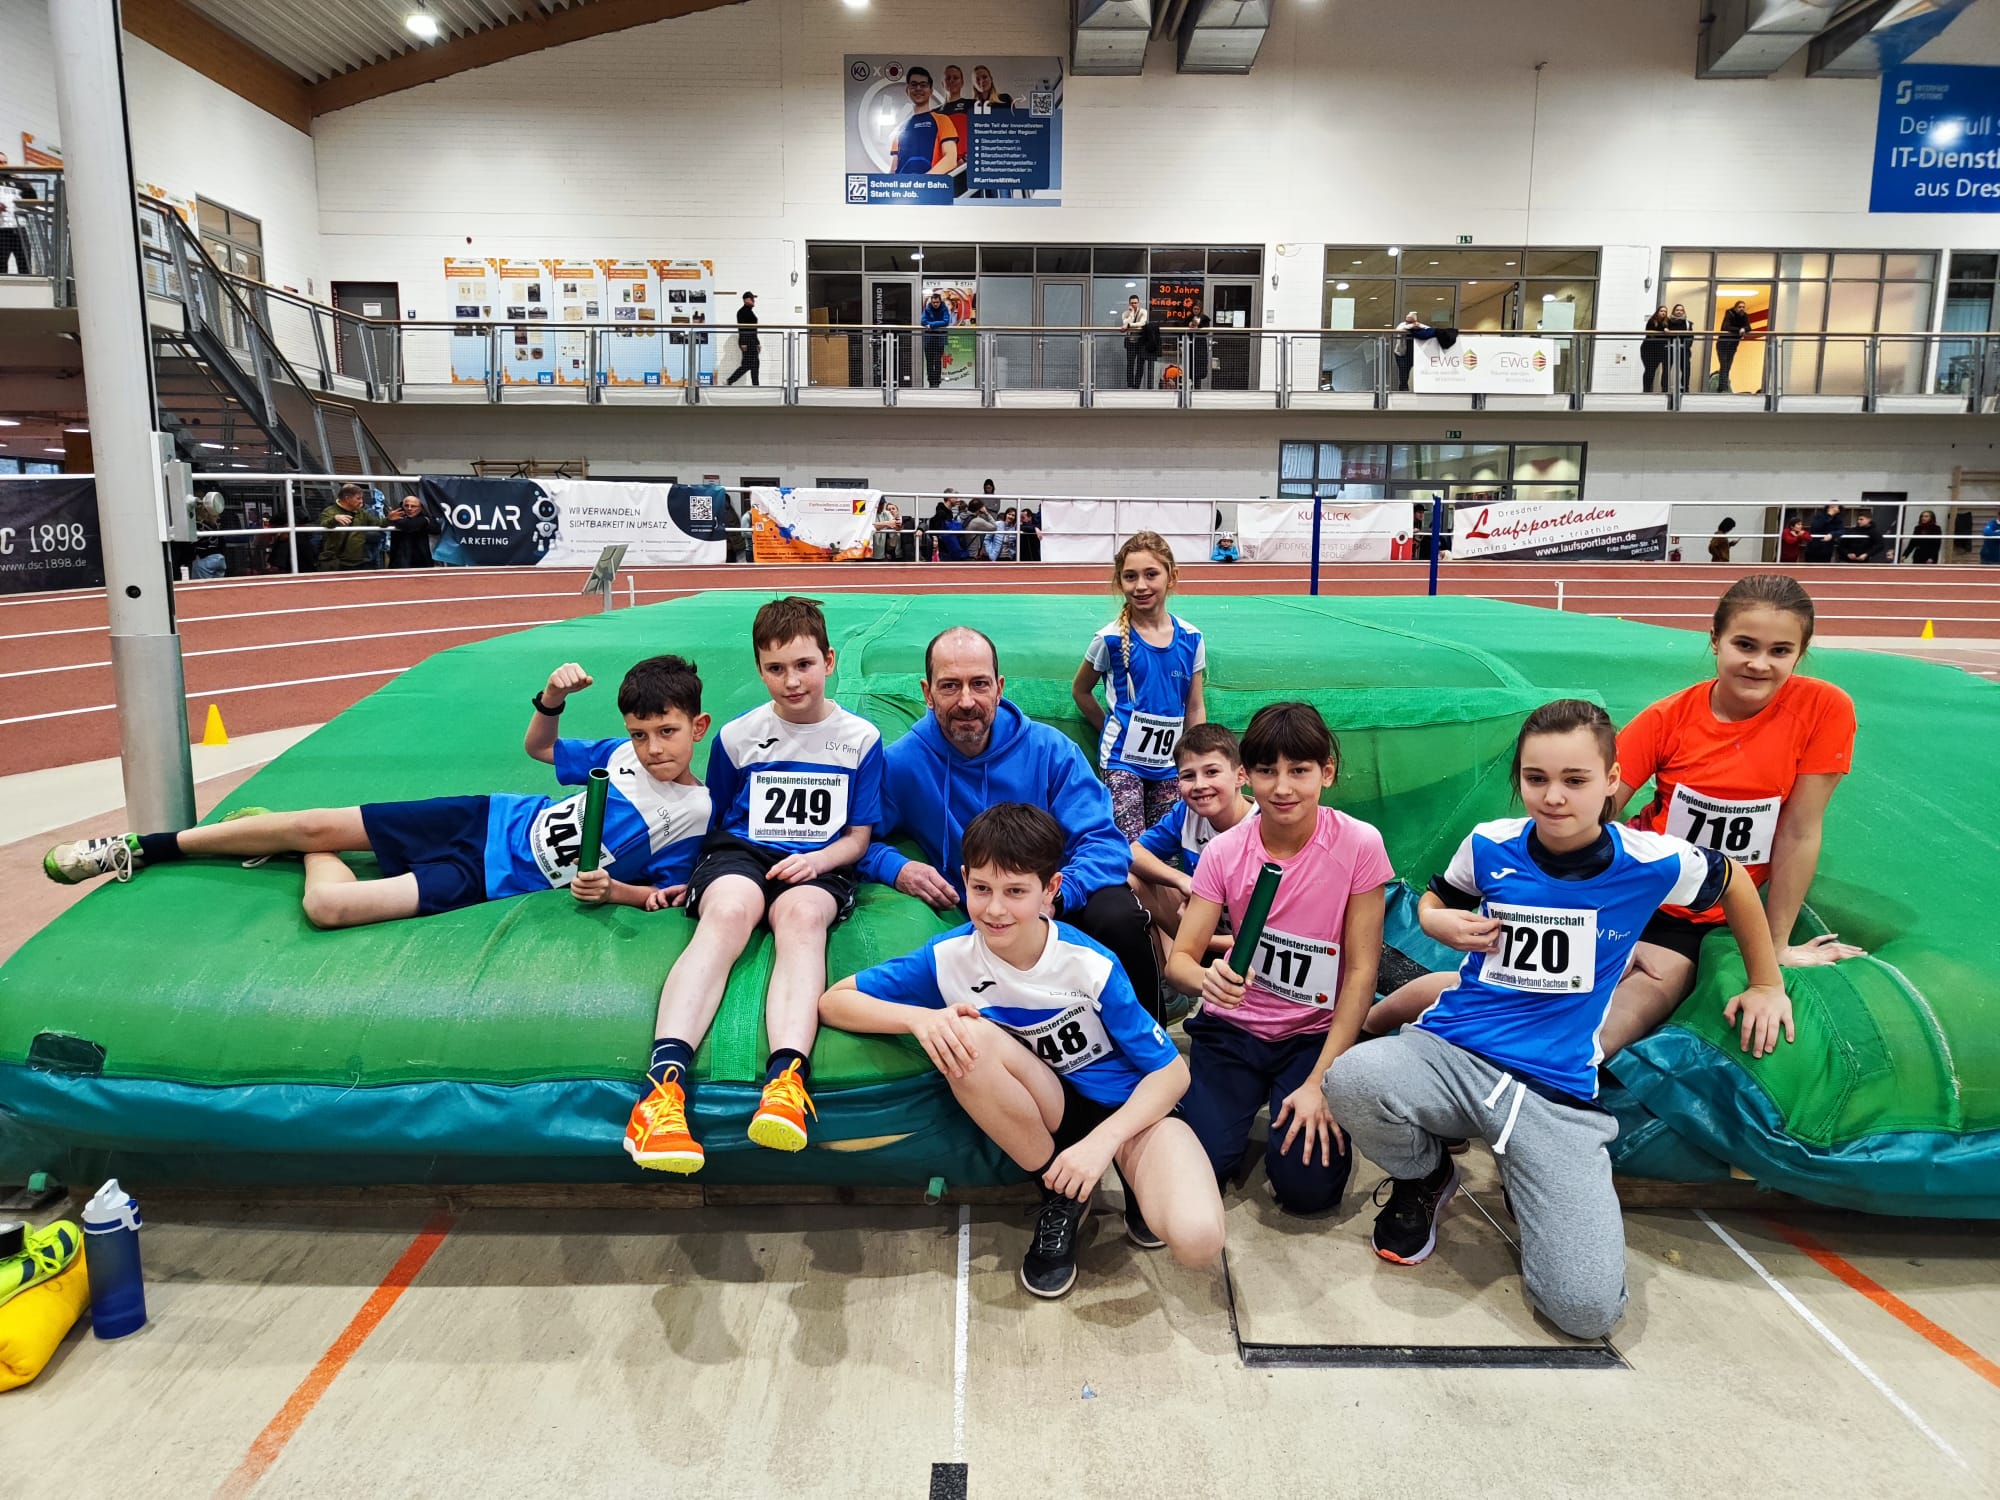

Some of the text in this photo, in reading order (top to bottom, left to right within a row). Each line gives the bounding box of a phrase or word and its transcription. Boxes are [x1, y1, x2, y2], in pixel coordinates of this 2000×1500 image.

[870, 180, 949, 189] Schnell auf der Bahn.
[1914, 182, 1949, 197] aus
[870, 190, 890, 198] Stark
[891, 190, 901, 198] im
[902, 190, 919, 198] Job.
[1159, 285, 1200, 294] 30 Jahre
[1151, 298, 1182, 306] Kinder
[1166, 309, 1192, 319] proje
[1430, 356, 1460, 368] EWG
[1500, 356, 1529, 369] EWG
[582, 506, 641, 516] VERWANDELN
[1297, 511, 1351, 521] KUKLICK
[1498, 504, 1543, 518] Dresdner
[626, 520, 635, 529] IN
[637, 520, 668, 529] UMSATZ
[1465, 506, 1617, 540] Laufsportladen
[28, 523, 86, 553] 1898
[460, 537, 509, 546] ARKETING
[1522, 534, 1555, 547] skiing
[1570, 523, 1619, 538] triathlon
[1535, 531, 1637, 557] www.laufsportladen.de
[825, 741, 840, 751] LSV
[1137, 726, 1175, 756] 719
[756, 775, 841, 787] Regionalmeisterschaft
[764, 787, 832, 826] 249
[1677, 790, 1772, 814] Regionalmeisterschaft
[545, 803, 582, 868] 244
[1685, 807, 1754, 851] 718
[1490, 908, 1585, 927] Regionalmeisterschaft
[1260, 929, 1329, 955] onalmeisterschaf
[1501, 924, 1570, 974] 720
[1259, 941, 1312, 988] 717
[1542, 977, 1568, 989] Sachsen
[1018, 1021, 1088, 1065] 48
